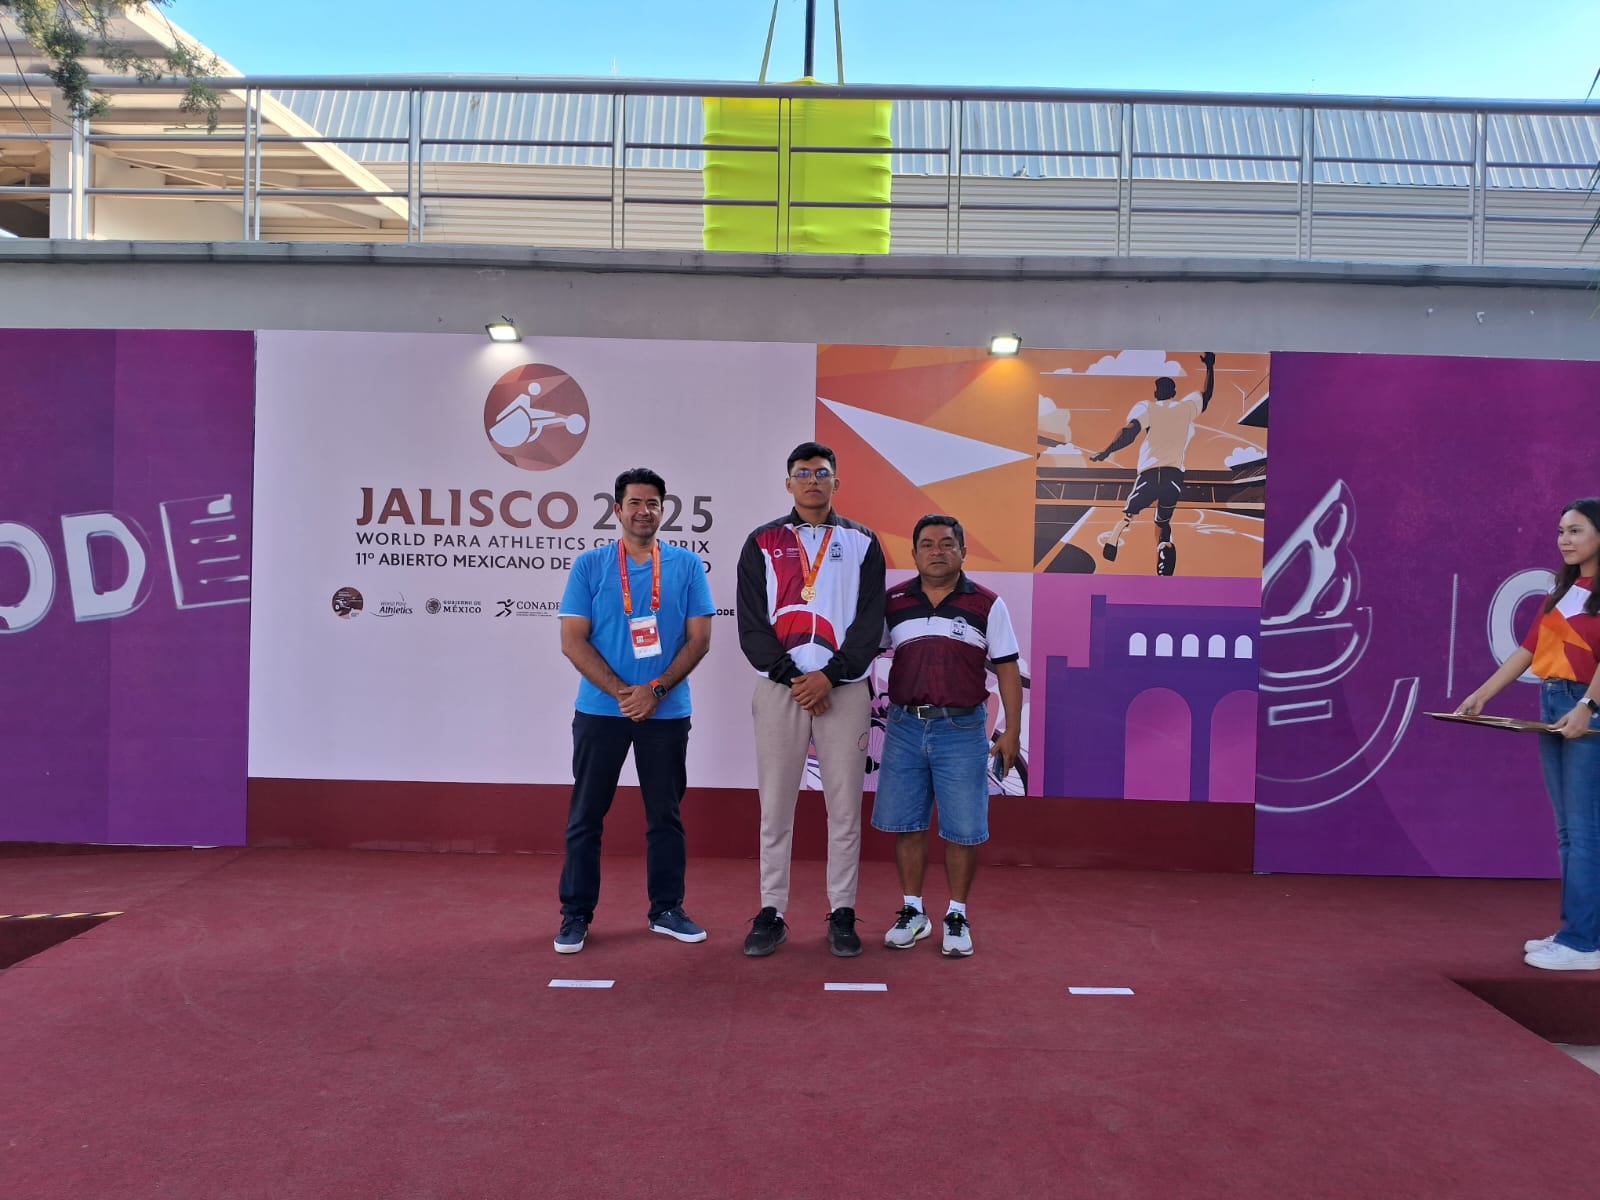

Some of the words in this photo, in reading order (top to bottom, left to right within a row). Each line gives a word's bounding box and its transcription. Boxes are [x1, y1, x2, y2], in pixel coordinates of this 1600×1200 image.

[356, 487, 579, 529] JALISCO
[593, 492, 713, 533] 225
[356, 532, 426, 546] WORLD
[434, 533, 481, 548] PARA
[488, 535, 586, 551] ATHLETICS
[379, 553, 448, 568] ABIERTO
[453, 555, 545, 570] MEXICANO
[551, 557, 571, 570] DE
[443, 604, 482, 613] MÉXICO
